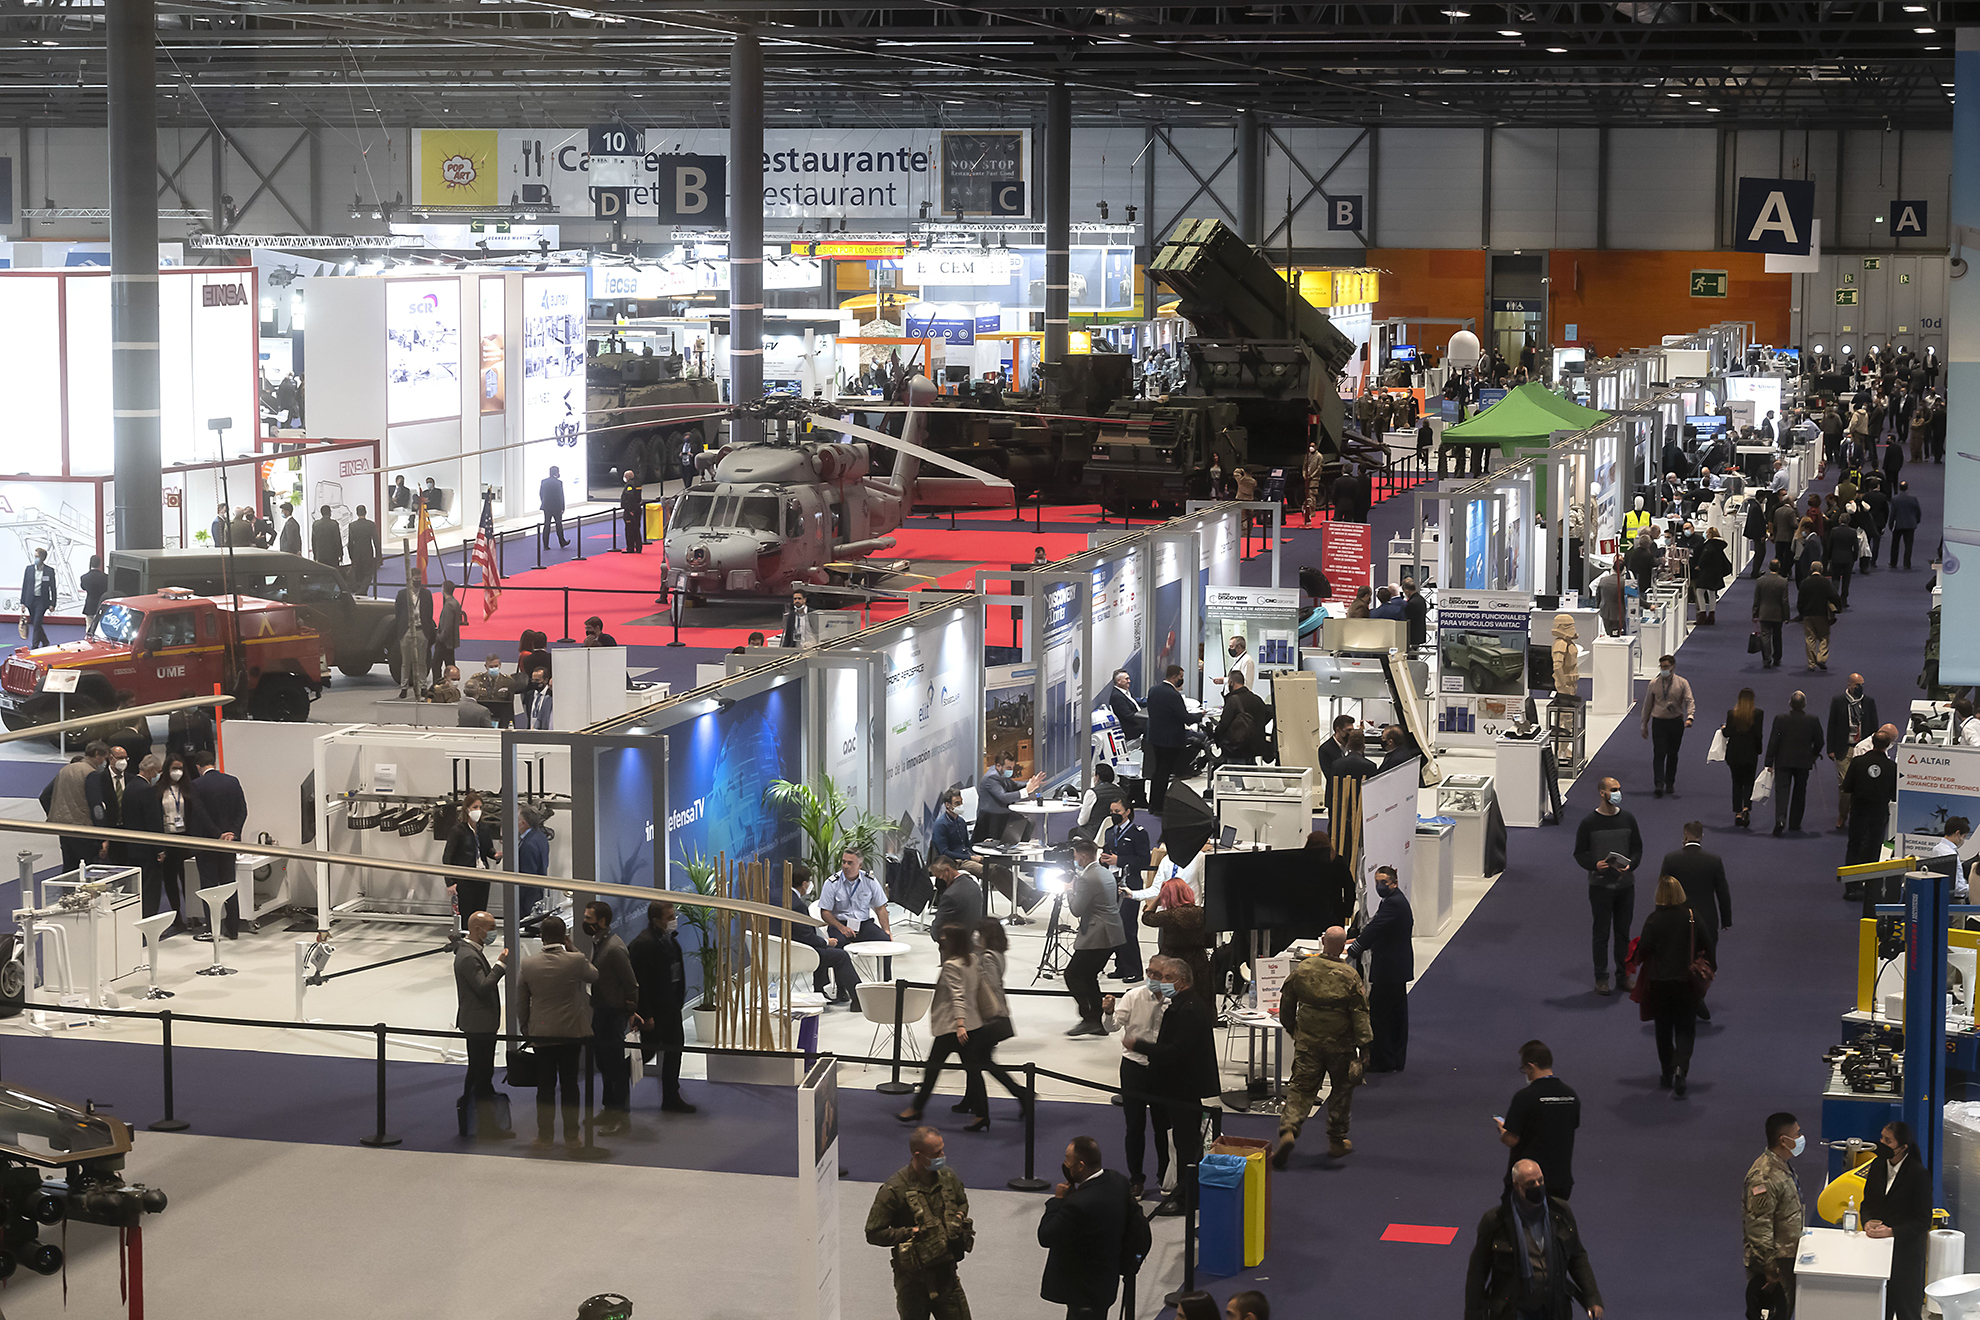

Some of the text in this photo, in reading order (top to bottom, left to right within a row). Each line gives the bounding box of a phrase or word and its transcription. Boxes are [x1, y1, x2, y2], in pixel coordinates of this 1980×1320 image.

[602, 132, 626, 152] 10
[447, 164, 465, 174] POP
[763, 147, 928, 172] estaurante
[951, 160, 980, 170] NON
[982, 160, 1015, 170] STOP
[454, 171, 472, 182] ART
[675, 167, 708, 214] B
[763, 181, 897, 206] estaurant
[999, 186, 1018, 211] C
[601, 193, 620, 216] D
[1337, 202, 1355, 224] B
[1747, 191, 1799, 243] A
[1895, 206, 1922, 232] A
[604, 272, 637, 294] fecsa
[203, 283, 248, 307] EINSA
[340, 458, 370, 477] EINSA
[1440, 612, 1526, 621] PROTOTIPOS FUNCIONALES
[156, 665, 186, 679] UME
[1920, 757, 1951, 766] ALTAIR
[1906, 773, 1942, 782] SIMULATION
[1906, 780, 1980, 792] ADVANCED ELECTRONICS
